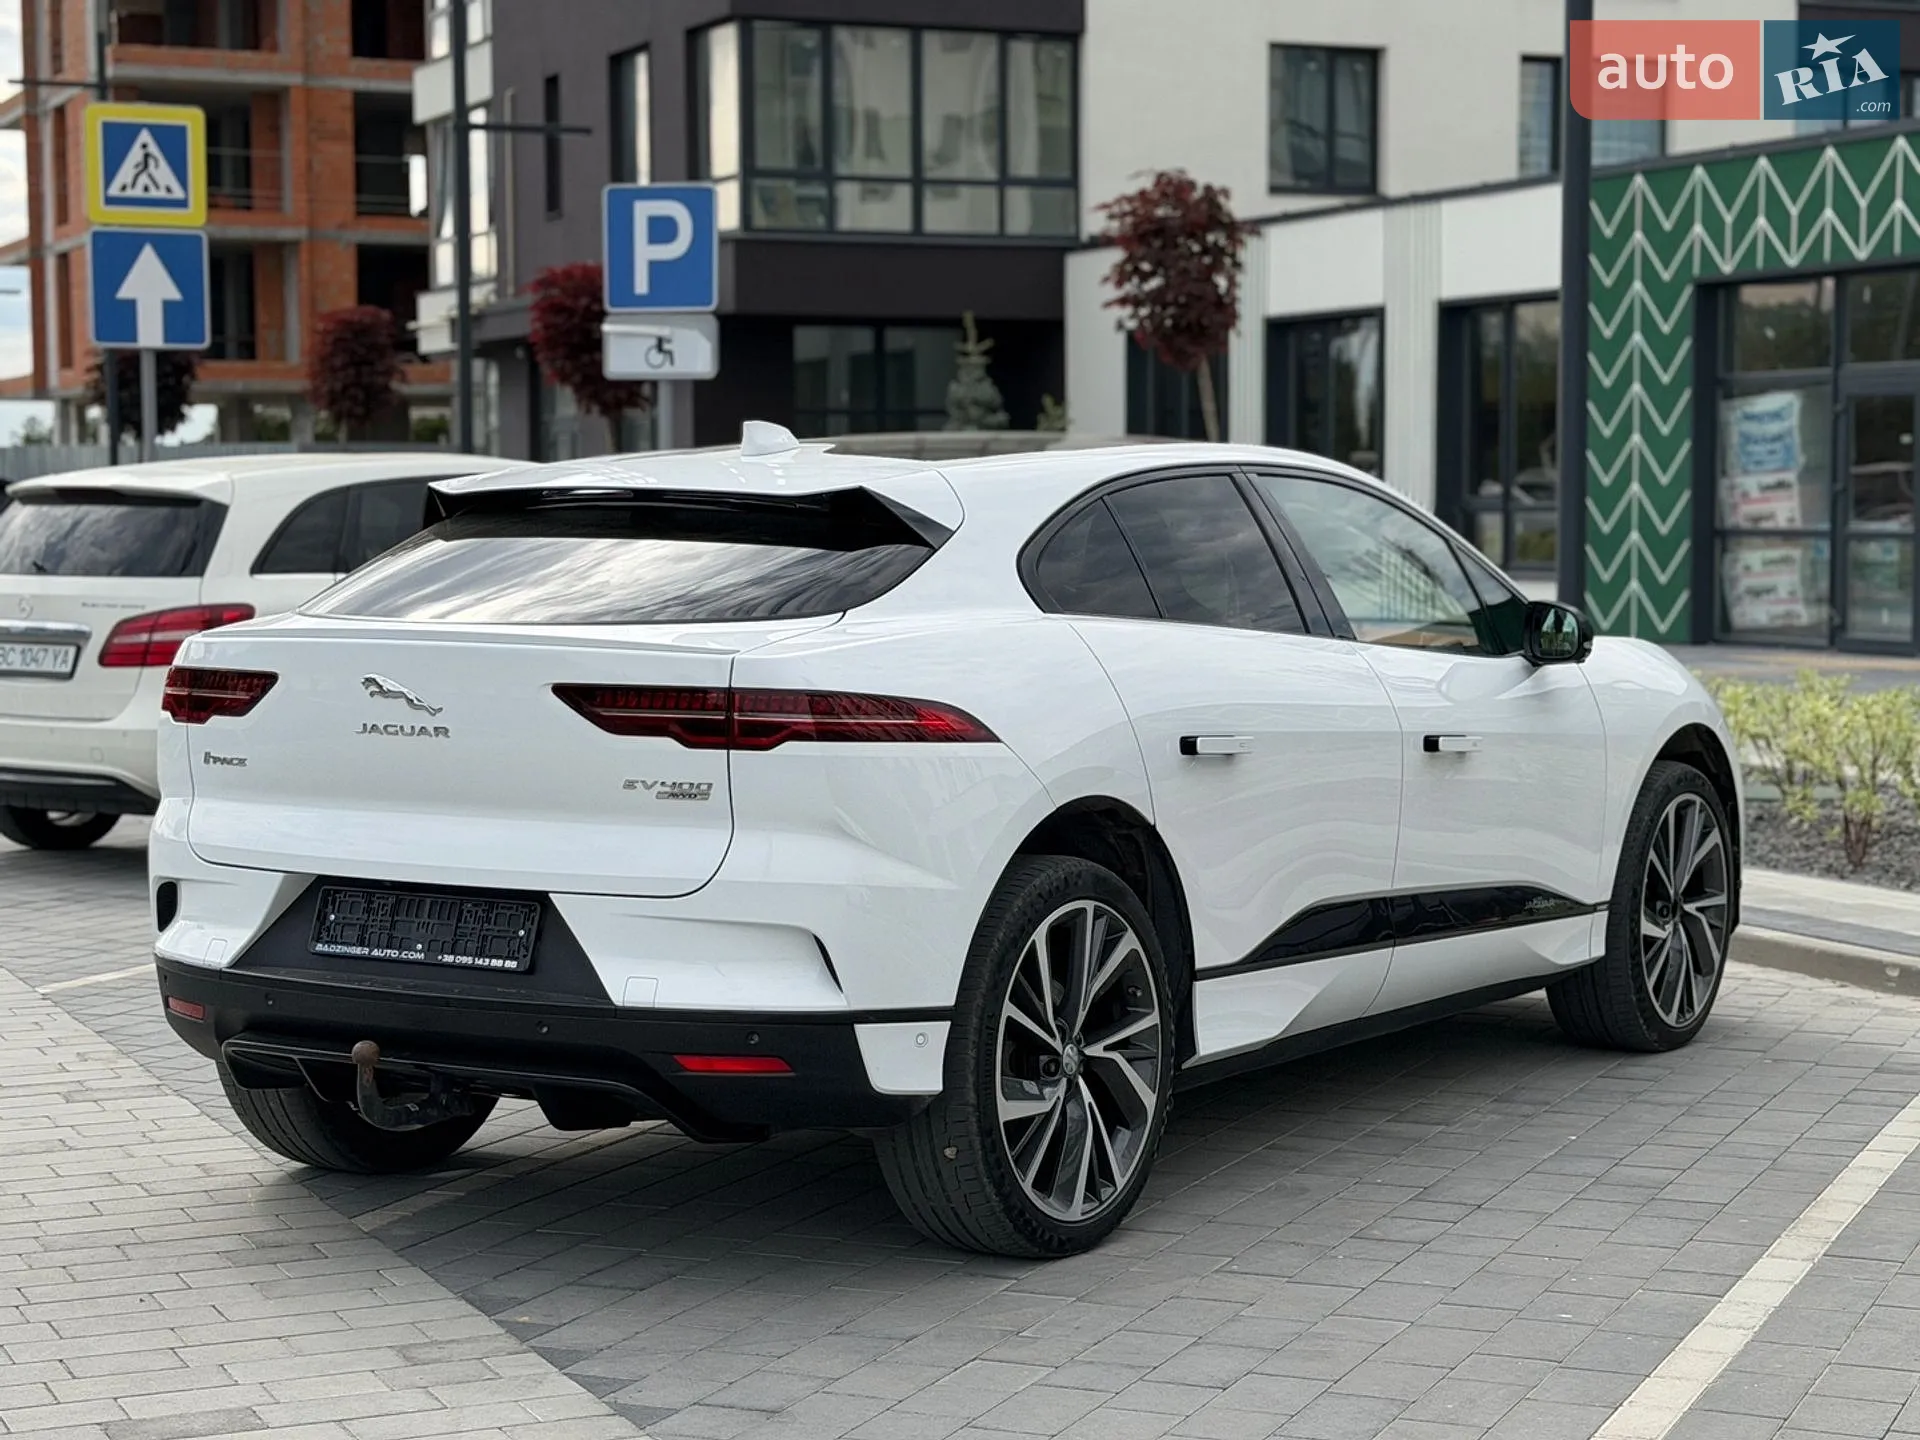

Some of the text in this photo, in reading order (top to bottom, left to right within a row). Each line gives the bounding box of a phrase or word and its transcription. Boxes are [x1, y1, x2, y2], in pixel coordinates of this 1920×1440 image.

[633, 199, 694, 296] P
[20, 647, 49, 668] 1047
[353, 722, 451, 739] JAGUAR
[622, 779, 714, 793] EV400
